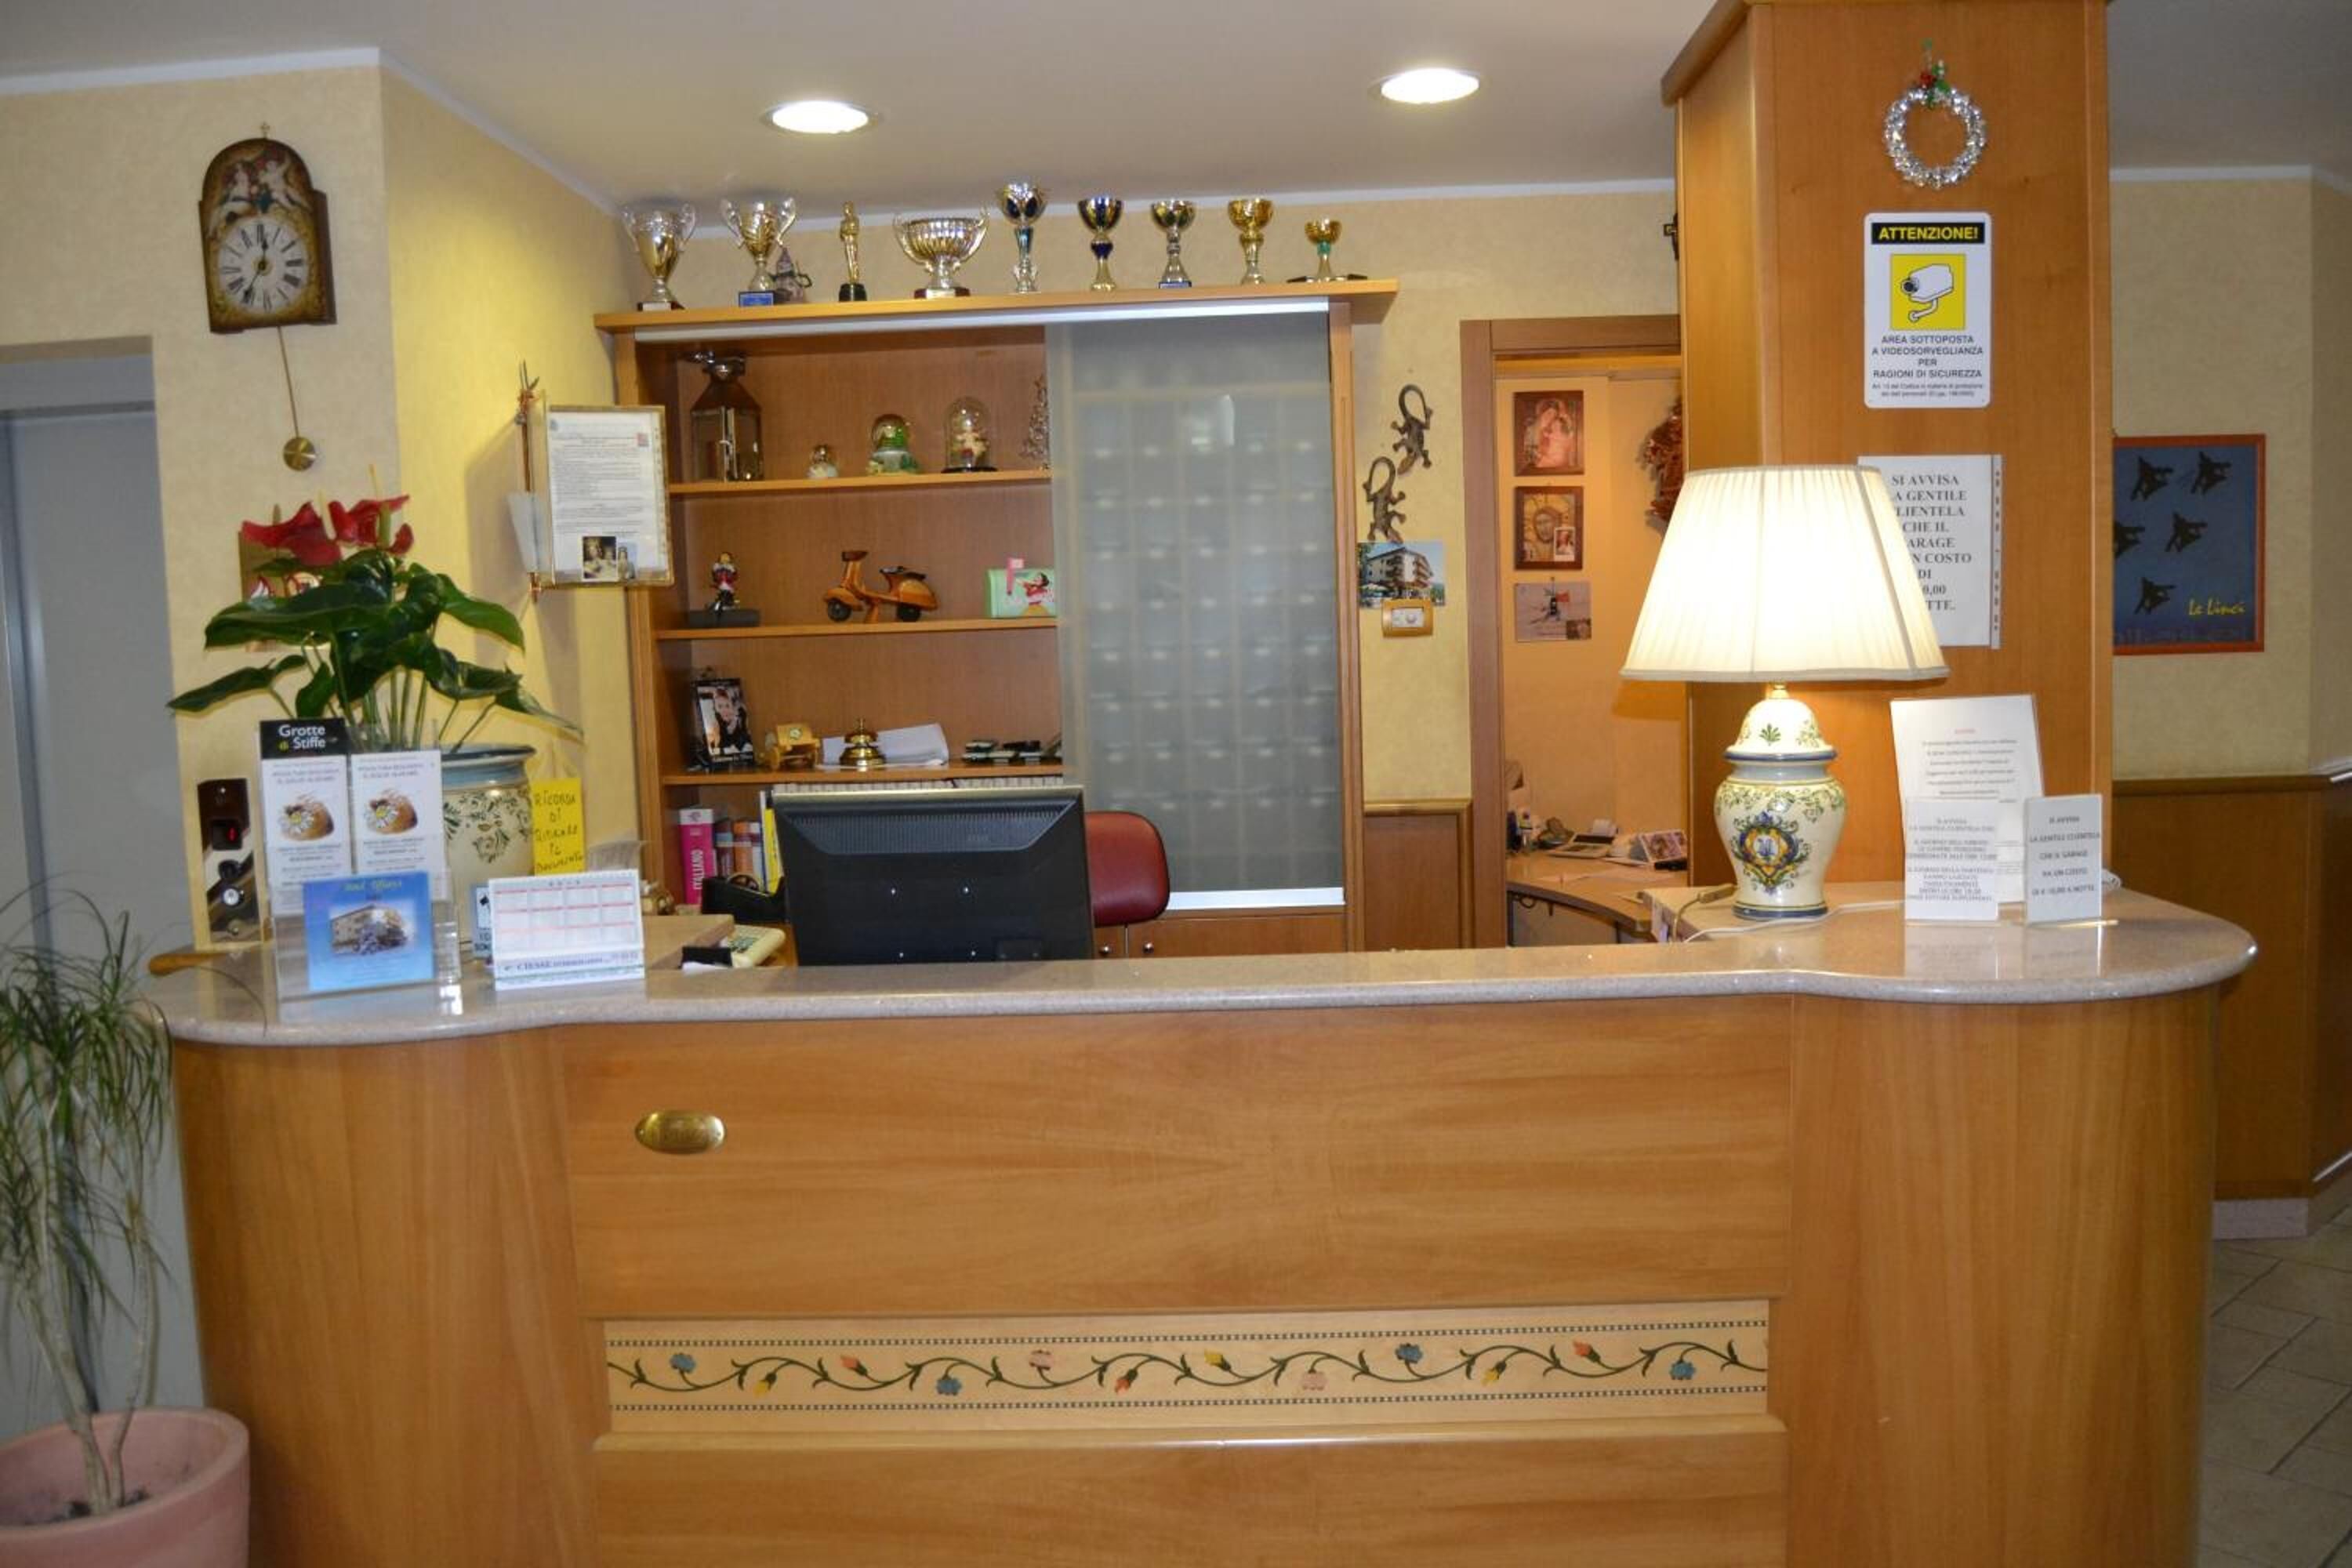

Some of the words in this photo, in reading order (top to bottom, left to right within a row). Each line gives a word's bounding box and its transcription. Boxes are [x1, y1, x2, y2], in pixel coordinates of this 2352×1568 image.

[1878, 227, 1979, 240] ATTENZIONE!
[1891, 475, 1904, 486] SI
[1908, 474, 1959, 485] AVVISA
[1906, 491, 1966, 501] GENTILE
[1894, 506, 1965, 517] LIENTELA
[1902, 521, 1933, 533] CHE
[1935, 521, 1949, 533] IL
[1907, 537, 1955, 549] ARAGE
[1924, 553, 1972, 564] COSTO
[1918, 568, 1932, 579] DI
[278, 724, 326, 737] Grotte
[292, 736, 326, 750] Stiffe
